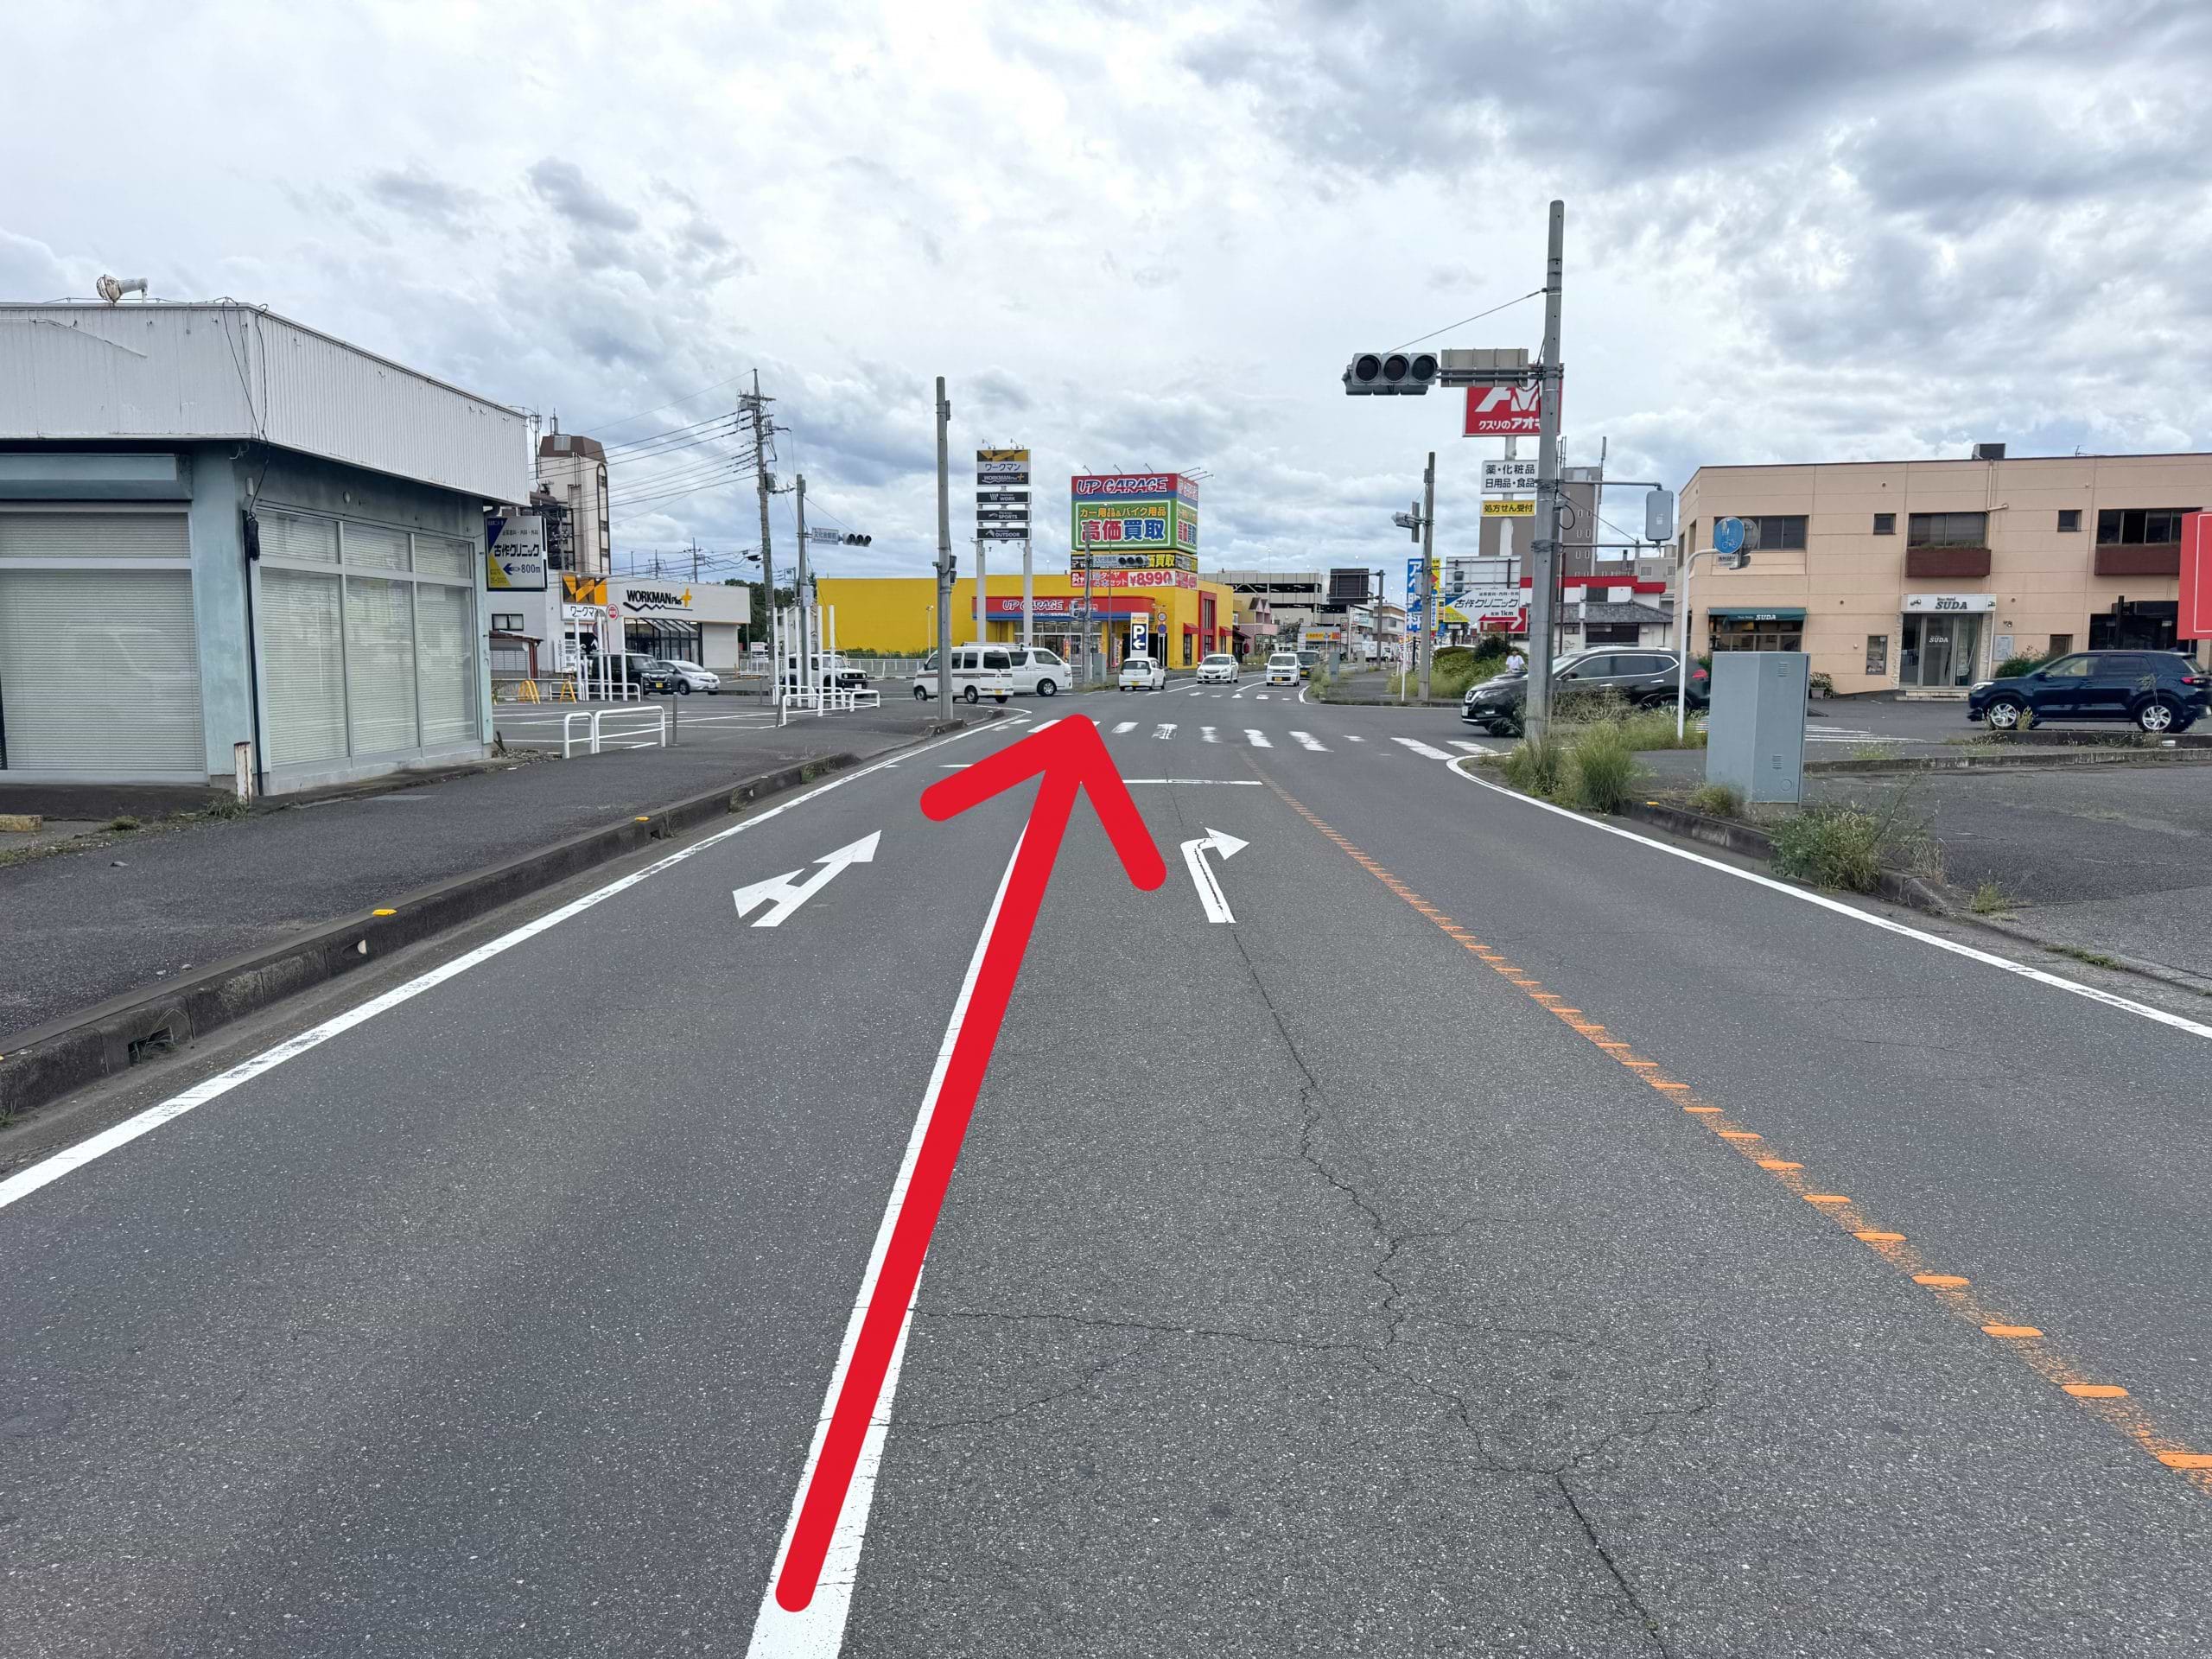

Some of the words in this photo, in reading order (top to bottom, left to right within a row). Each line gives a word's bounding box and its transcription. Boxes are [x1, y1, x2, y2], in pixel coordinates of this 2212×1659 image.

[1485, 464, 1535, 474] 薬・化粧品
[1077, 480, 1101, 494] UP
[1103, 477, 1168, 493] GARAGE
[1485, 478, 1535, 488] 日用品・食品
[1484, 504, 1533, 512] 処方せん受付
[1081, 519, 1165, 541] 高価買取
[494, 543, 540, 557] 古作クリニック
[521, 564, 541, 573] 800m
[626, 589, 671, 605] WORKMAN
[1002, 601, 1020, 610] UP
[1454, 599, 1518, 608] 古作クリニック
[1133, 625, 1145, 639] P
